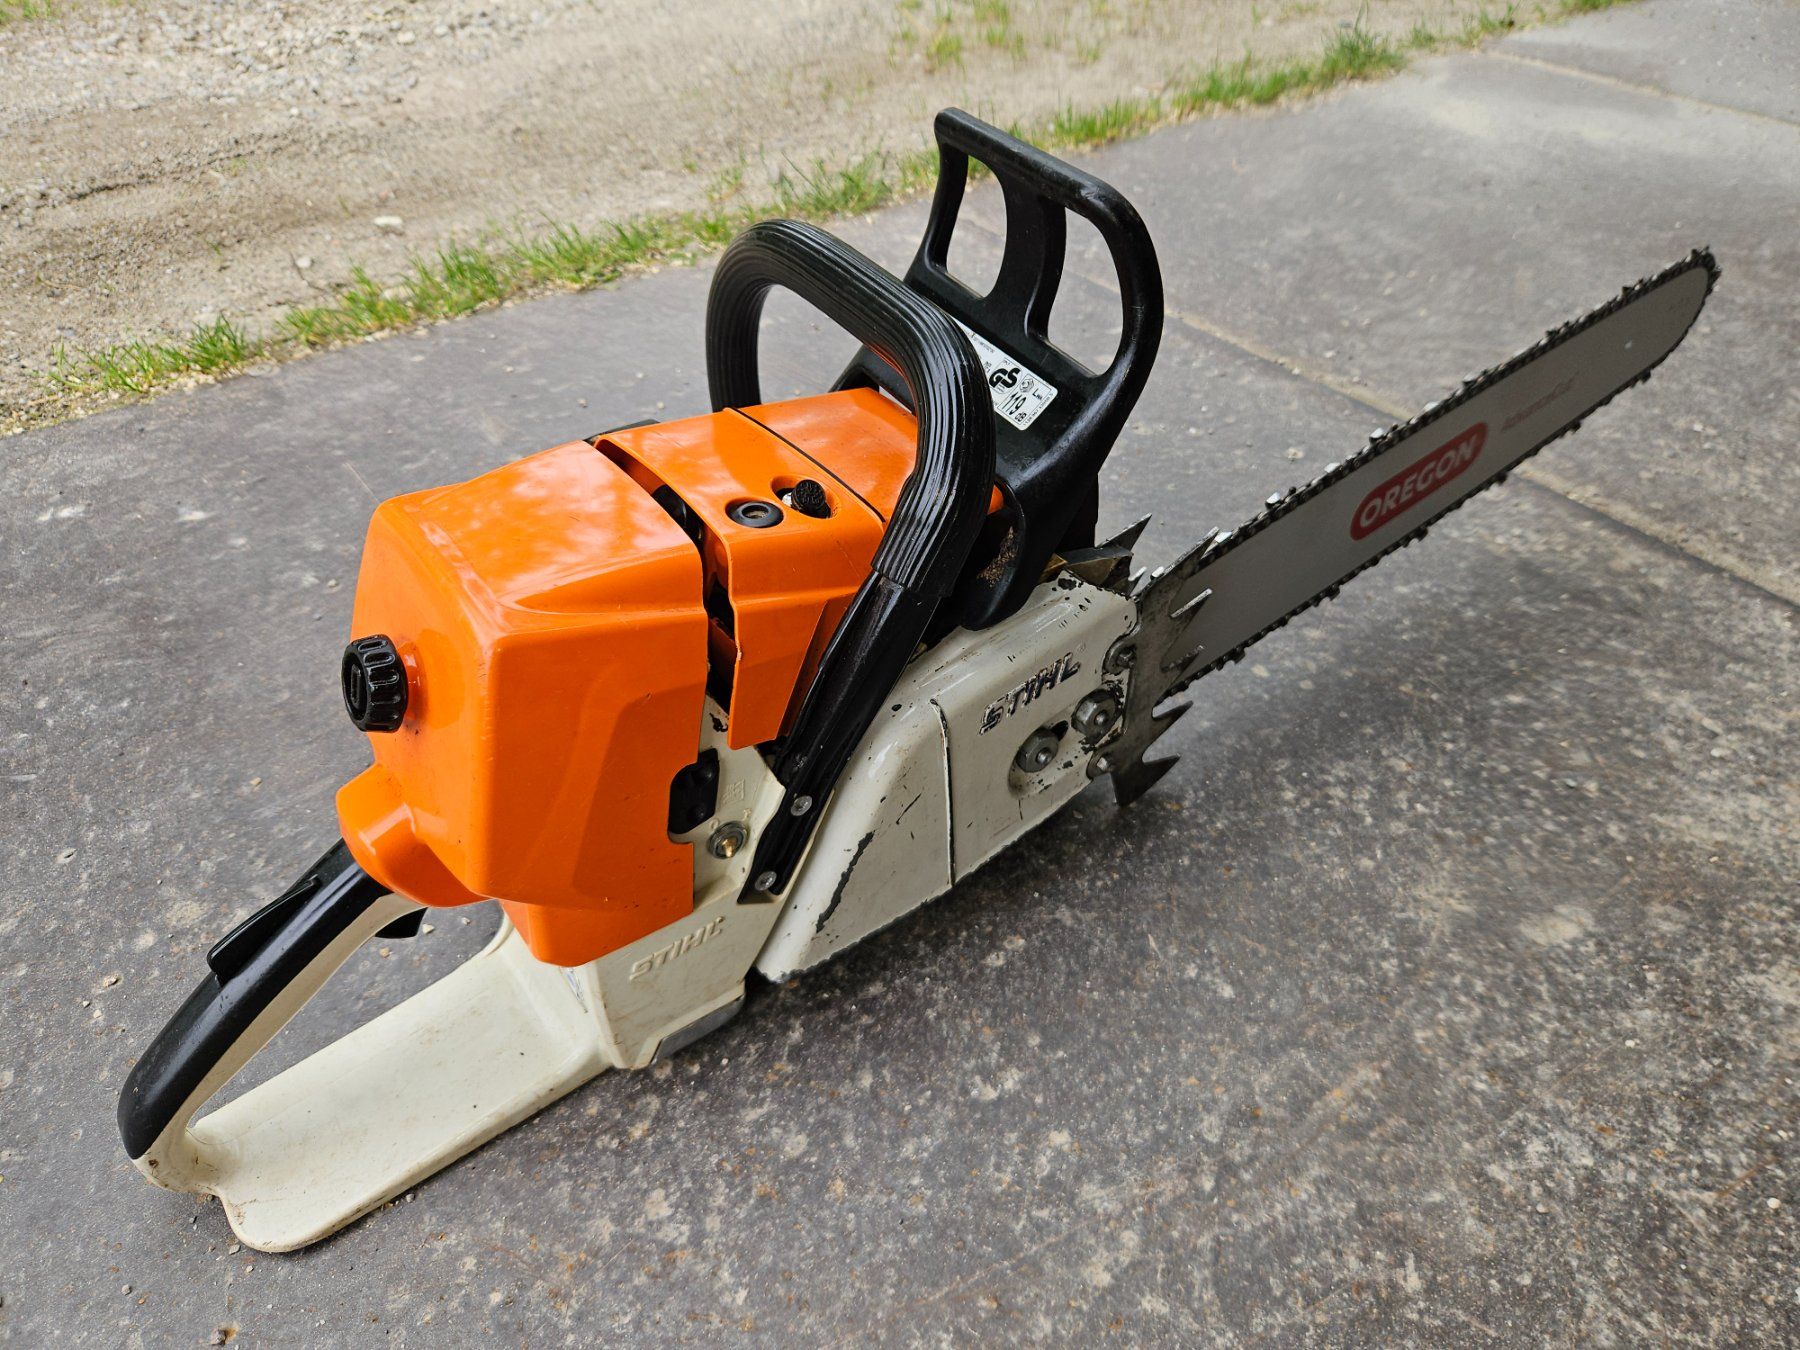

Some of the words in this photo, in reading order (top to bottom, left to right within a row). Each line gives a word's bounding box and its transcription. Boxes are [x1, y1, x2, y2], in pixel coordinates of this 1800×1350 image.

[989, 368, 1020, 388] GS
[1002, 391, 1027, 415] 119
[1015, 412, 1027, 422] dB
[1359, 433, 1481, 528] OREGON
[979, 651, 1081, 735] STIHL
[628, 916, 725, 981] STIHL
